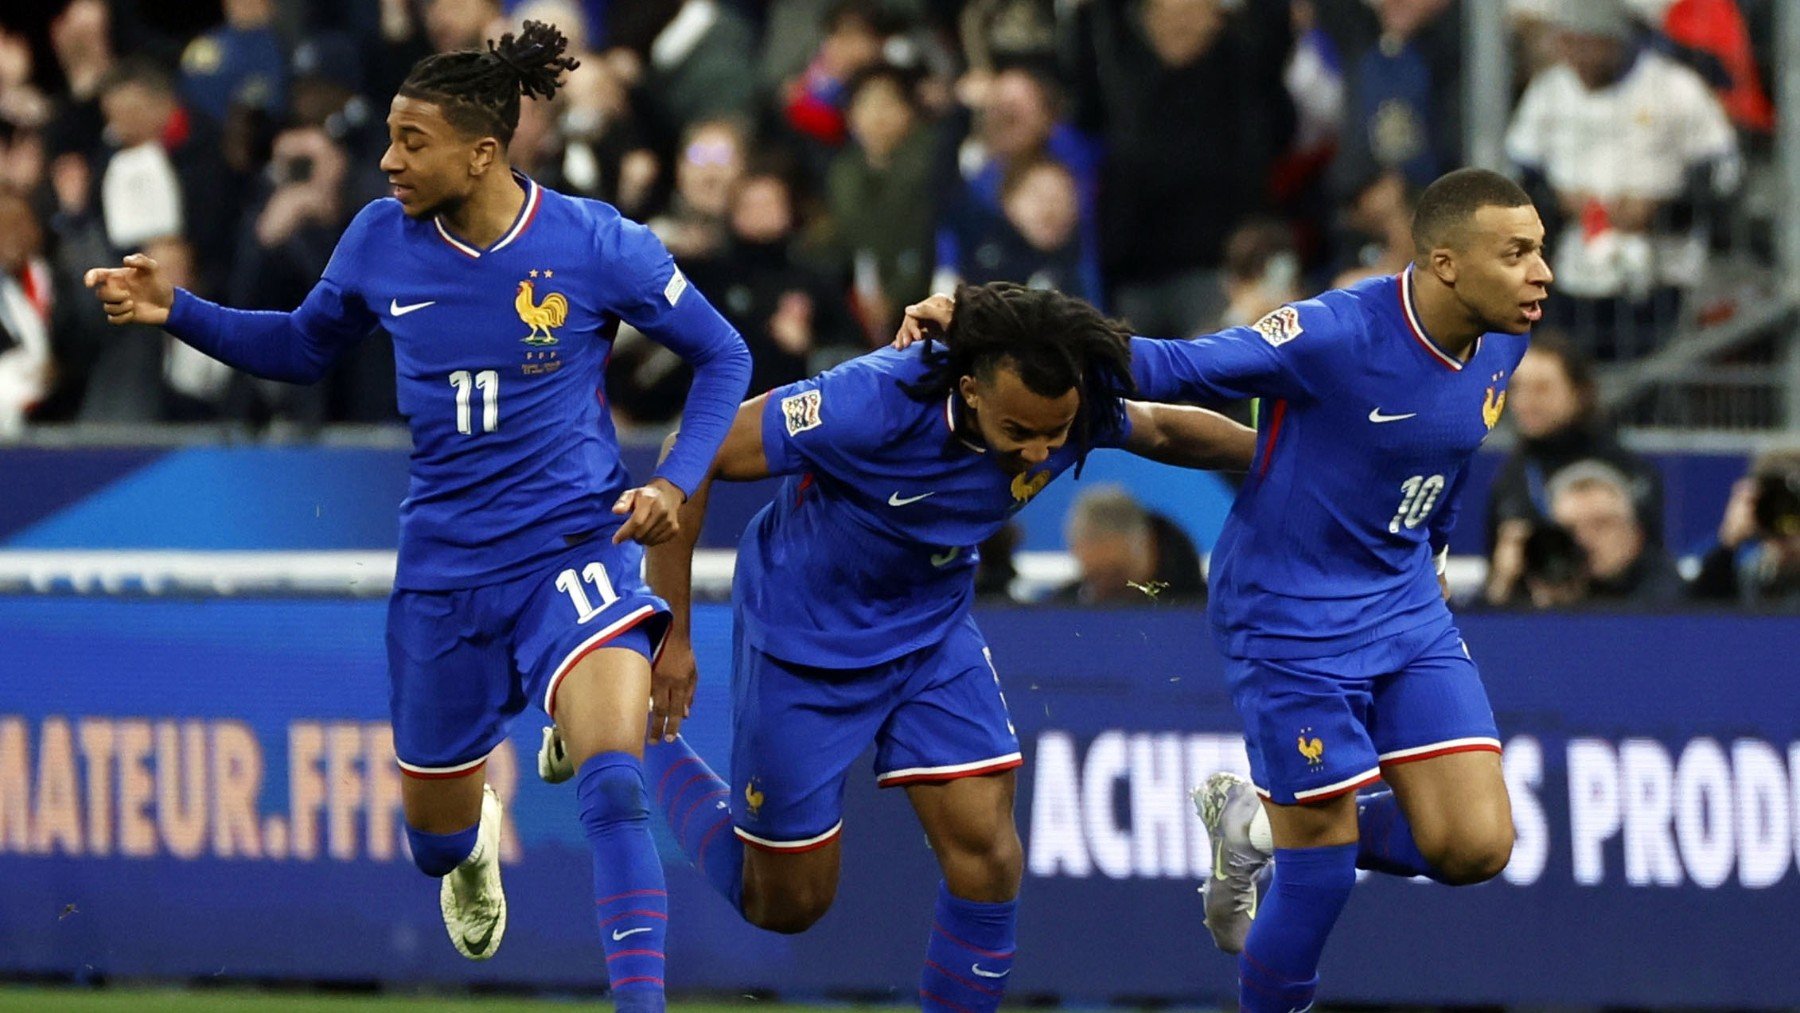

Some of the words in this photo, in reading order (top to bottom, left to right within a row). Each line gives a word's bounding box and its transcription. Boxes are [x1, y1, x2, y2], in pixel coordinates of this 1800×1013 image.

[449, 370, 498, 434] 11
[1389, 474, 1445, 534] 10
[555, 562, 621, 624] 11
